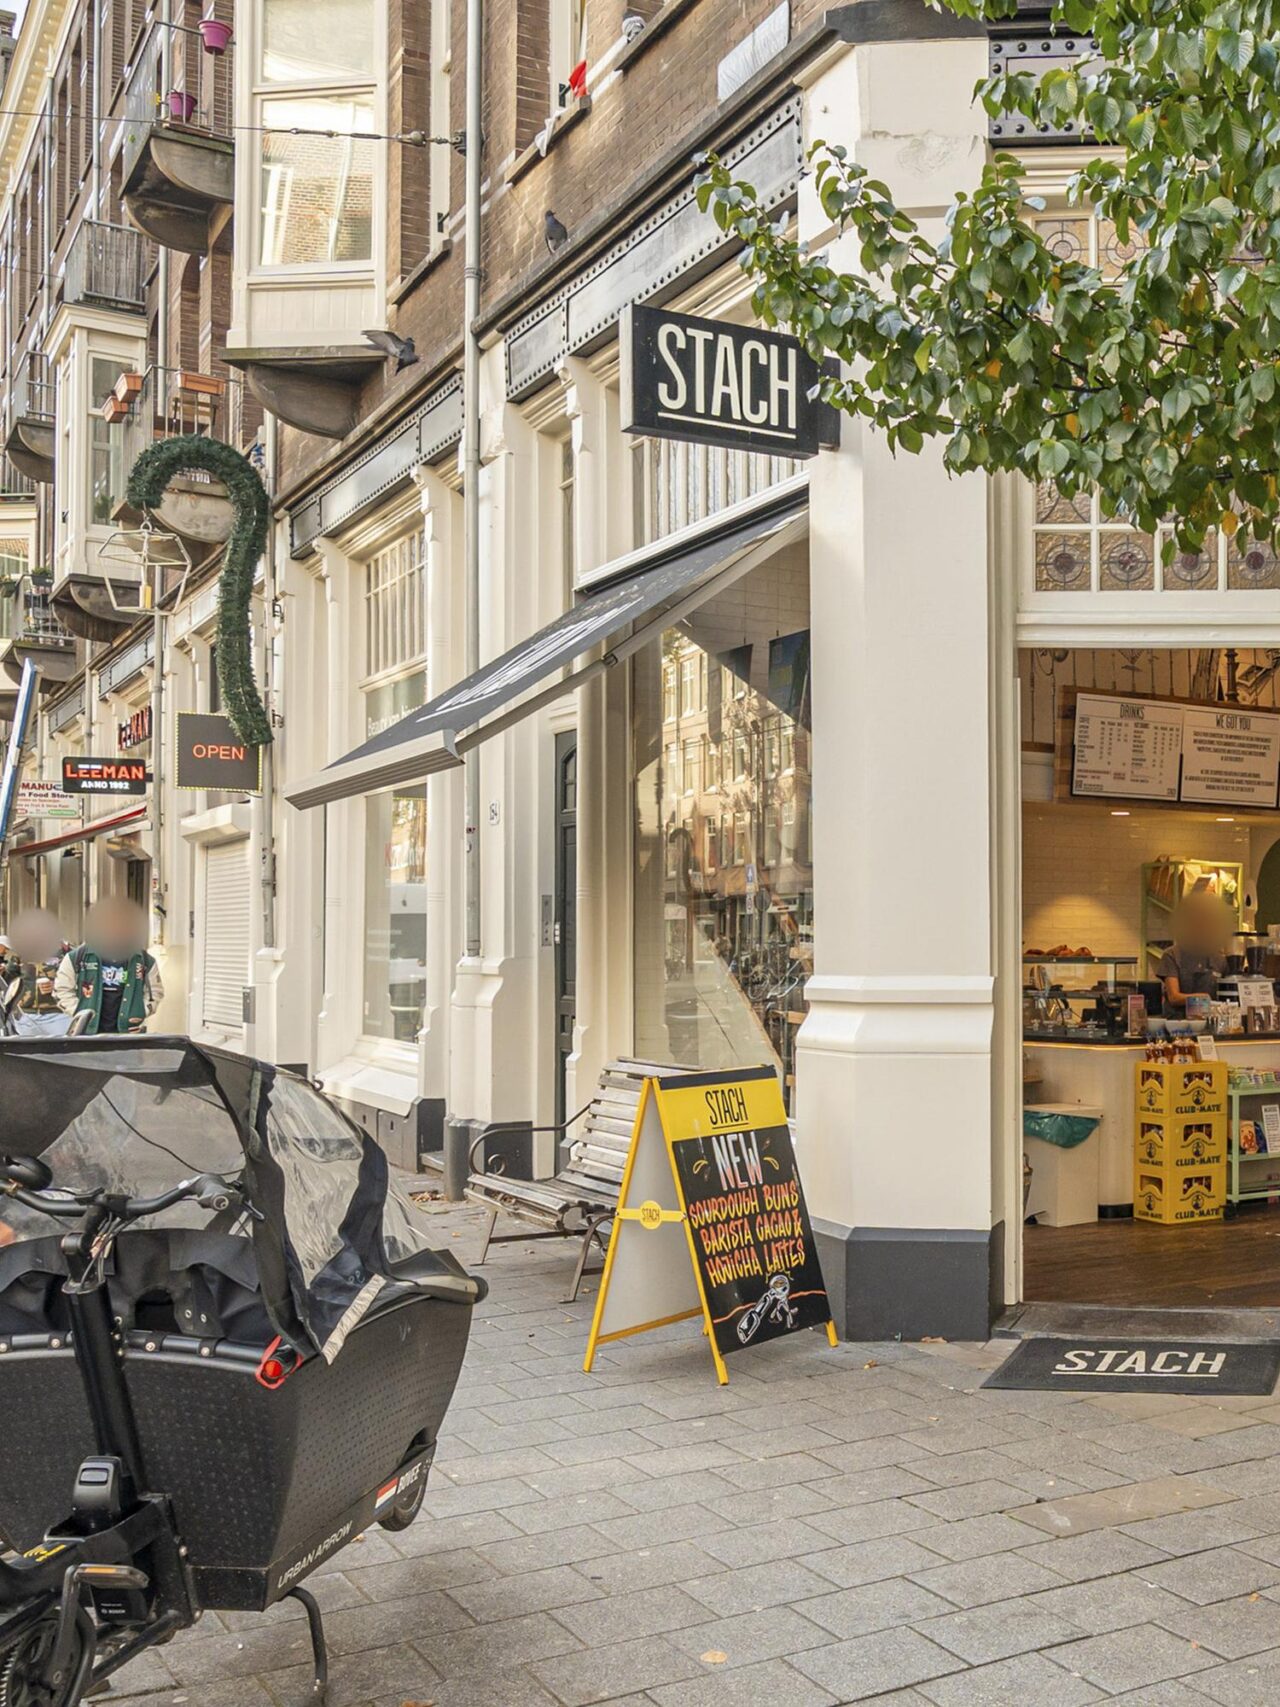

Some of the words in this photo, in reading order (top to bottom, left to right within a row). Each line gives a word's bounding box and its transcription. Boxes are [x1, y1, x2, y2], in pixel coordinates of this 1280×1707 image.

[658, 323, 797, 430] STACH
[1120, 704, 1145, 720] DRINKS
[192, 744, 245, 761] OPEN
[65, 763, 145, 781] LEEMAN
[80, 780, 108, 790] ANNO
[705, 1087, 749, 1126] STACH
[1175, 1104, 1221, 1114] CLUB-MATE
[712, 1131, 764, 1192] NEW
[1175, 1156, 1221, 1167] CLUB-MATE
[641, 1208, 660, 1221] STACH
[688, 1187, 760, 1229] SOURDOUGH
[763, 1179, 799, 1212] BUNS
[1175, 1208, 1221, 1219] CLUB-MATE
[699, 1217, 753, 1255] BARISTA
[763, 1238, 806, 1272] LATTES
[1055, 1349, 1227, 1374] STACH
[277, 1548, 317, 1589] URBAN
[313, 1520, 353, 1560] ARROW
